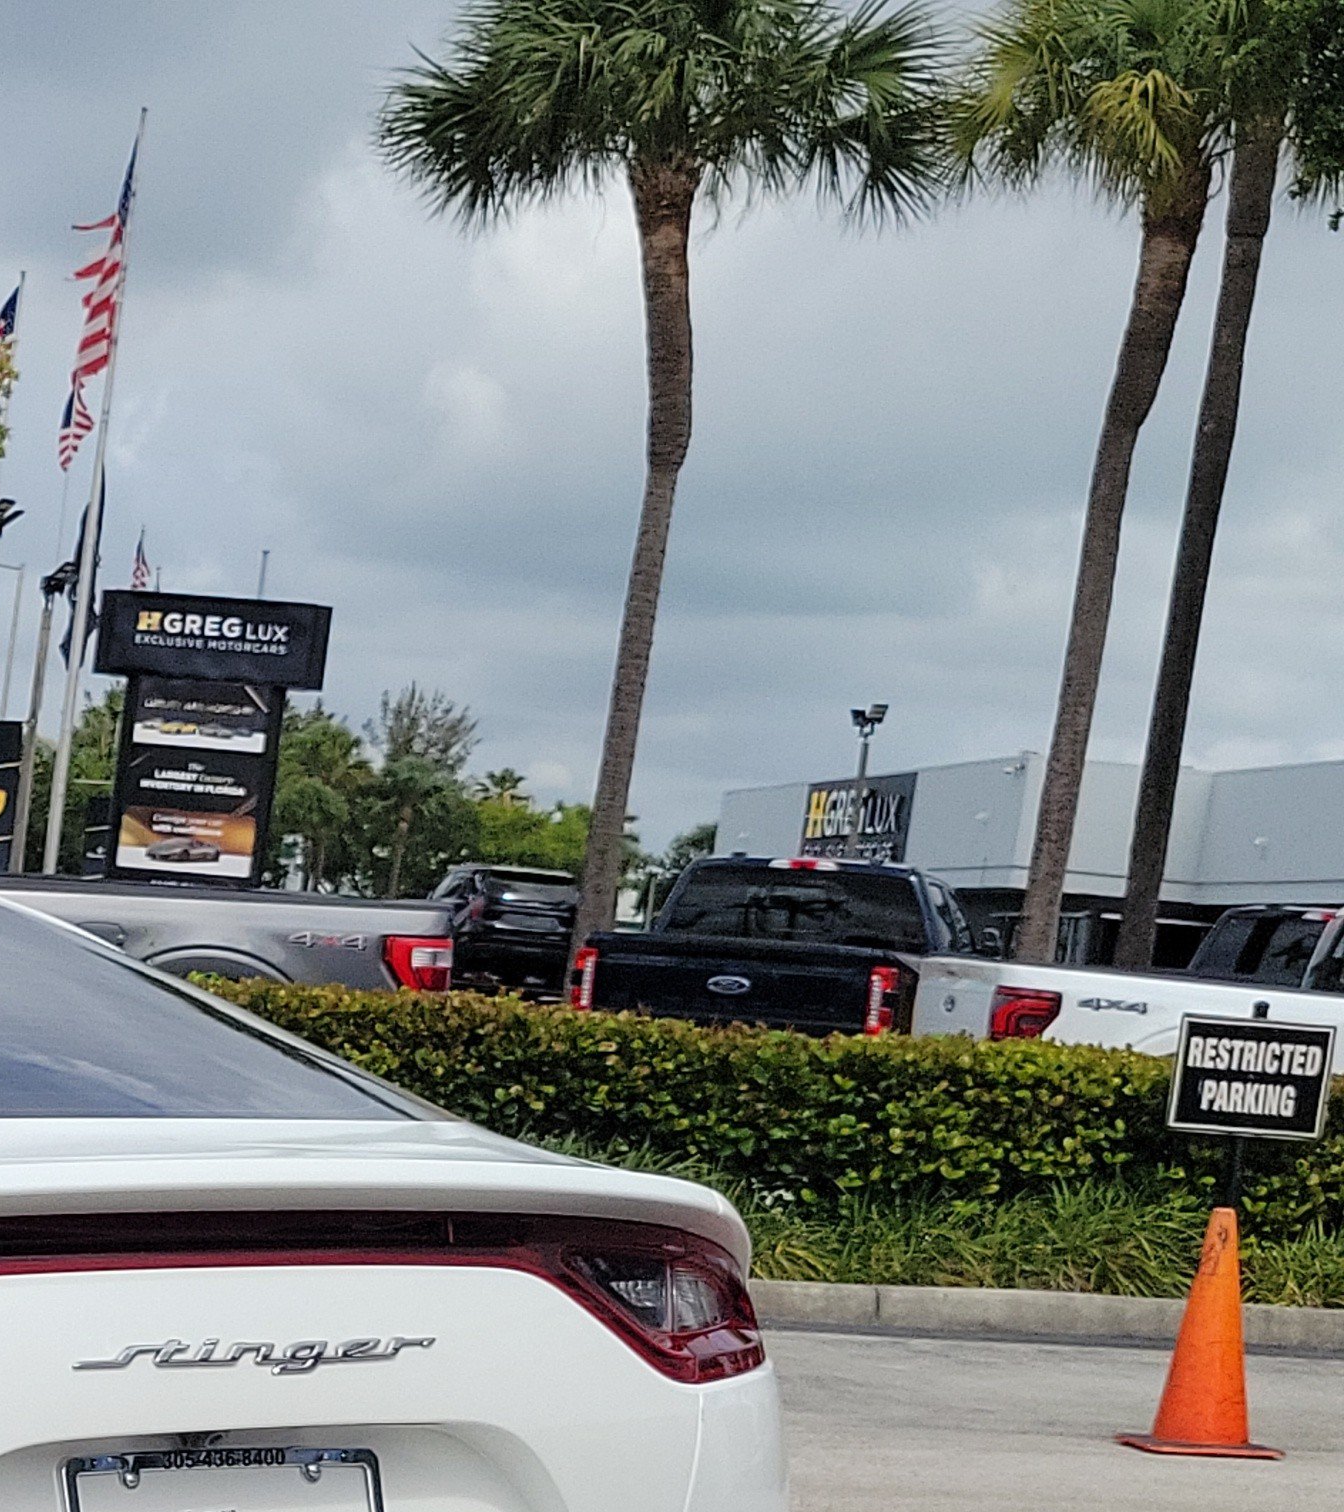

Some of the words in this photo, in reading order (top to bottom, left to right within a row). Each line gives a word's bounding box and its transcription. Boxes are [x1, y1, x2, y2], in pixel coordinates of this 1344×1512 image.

[245, 622, 290, 643] LUX
[133, 633, 205, 649] EXCLUSIVE
[207, 638, 288, 656] MOTORCARS
[1187, 1035, 1324, 1077] RESTRICTED
[1199, 1078, 1297, 1118] PARKING
[163, 1447, 286, 1469] 305-436-8400
